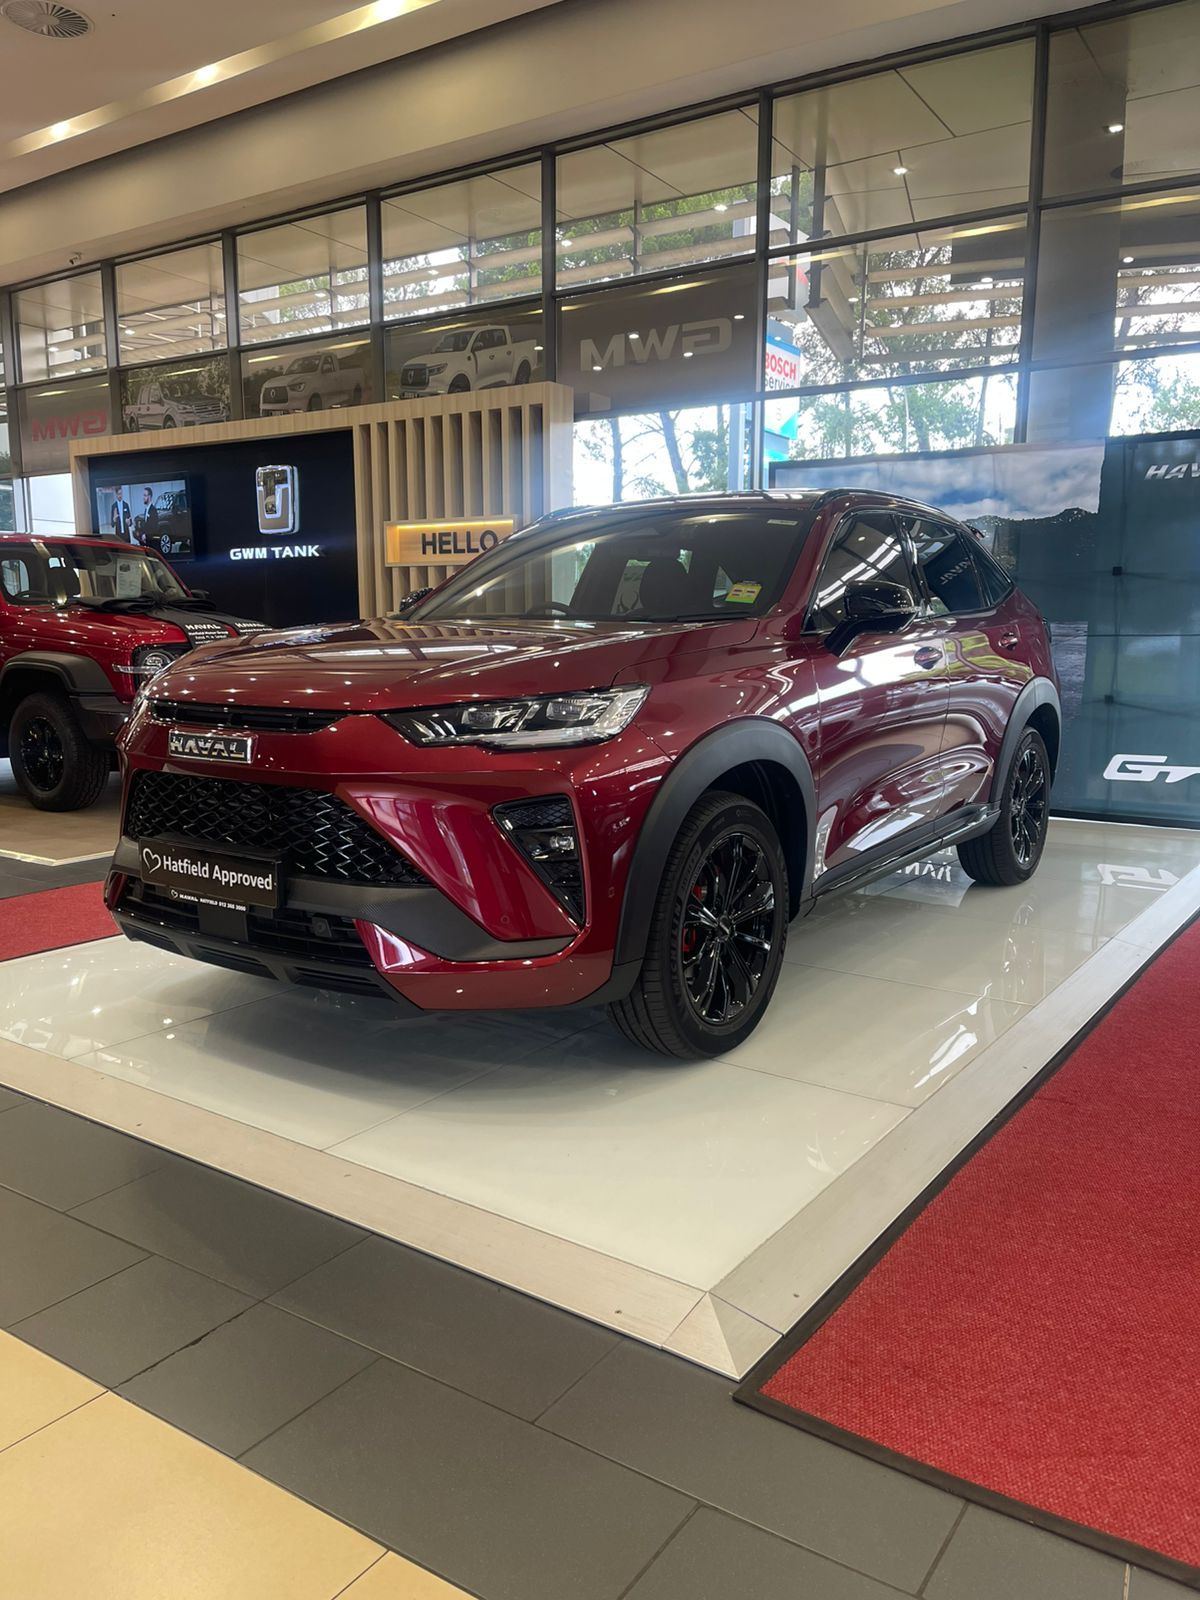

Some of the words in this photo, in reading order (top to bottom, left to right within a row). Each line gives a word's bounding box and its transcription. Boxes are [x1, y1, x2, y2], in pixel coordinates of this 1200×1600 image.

[765, 352, 797, 380] BOSCH
[229, 547, 268, 561] GWM
[270, 544, 320, 559] TANK
[421, 530, 498, 555] HELLO
[170, 736, 245, 758] HAVAL
[163, 855, 209, 879] Hatfield
[212, 864, 273, 890] Approved
